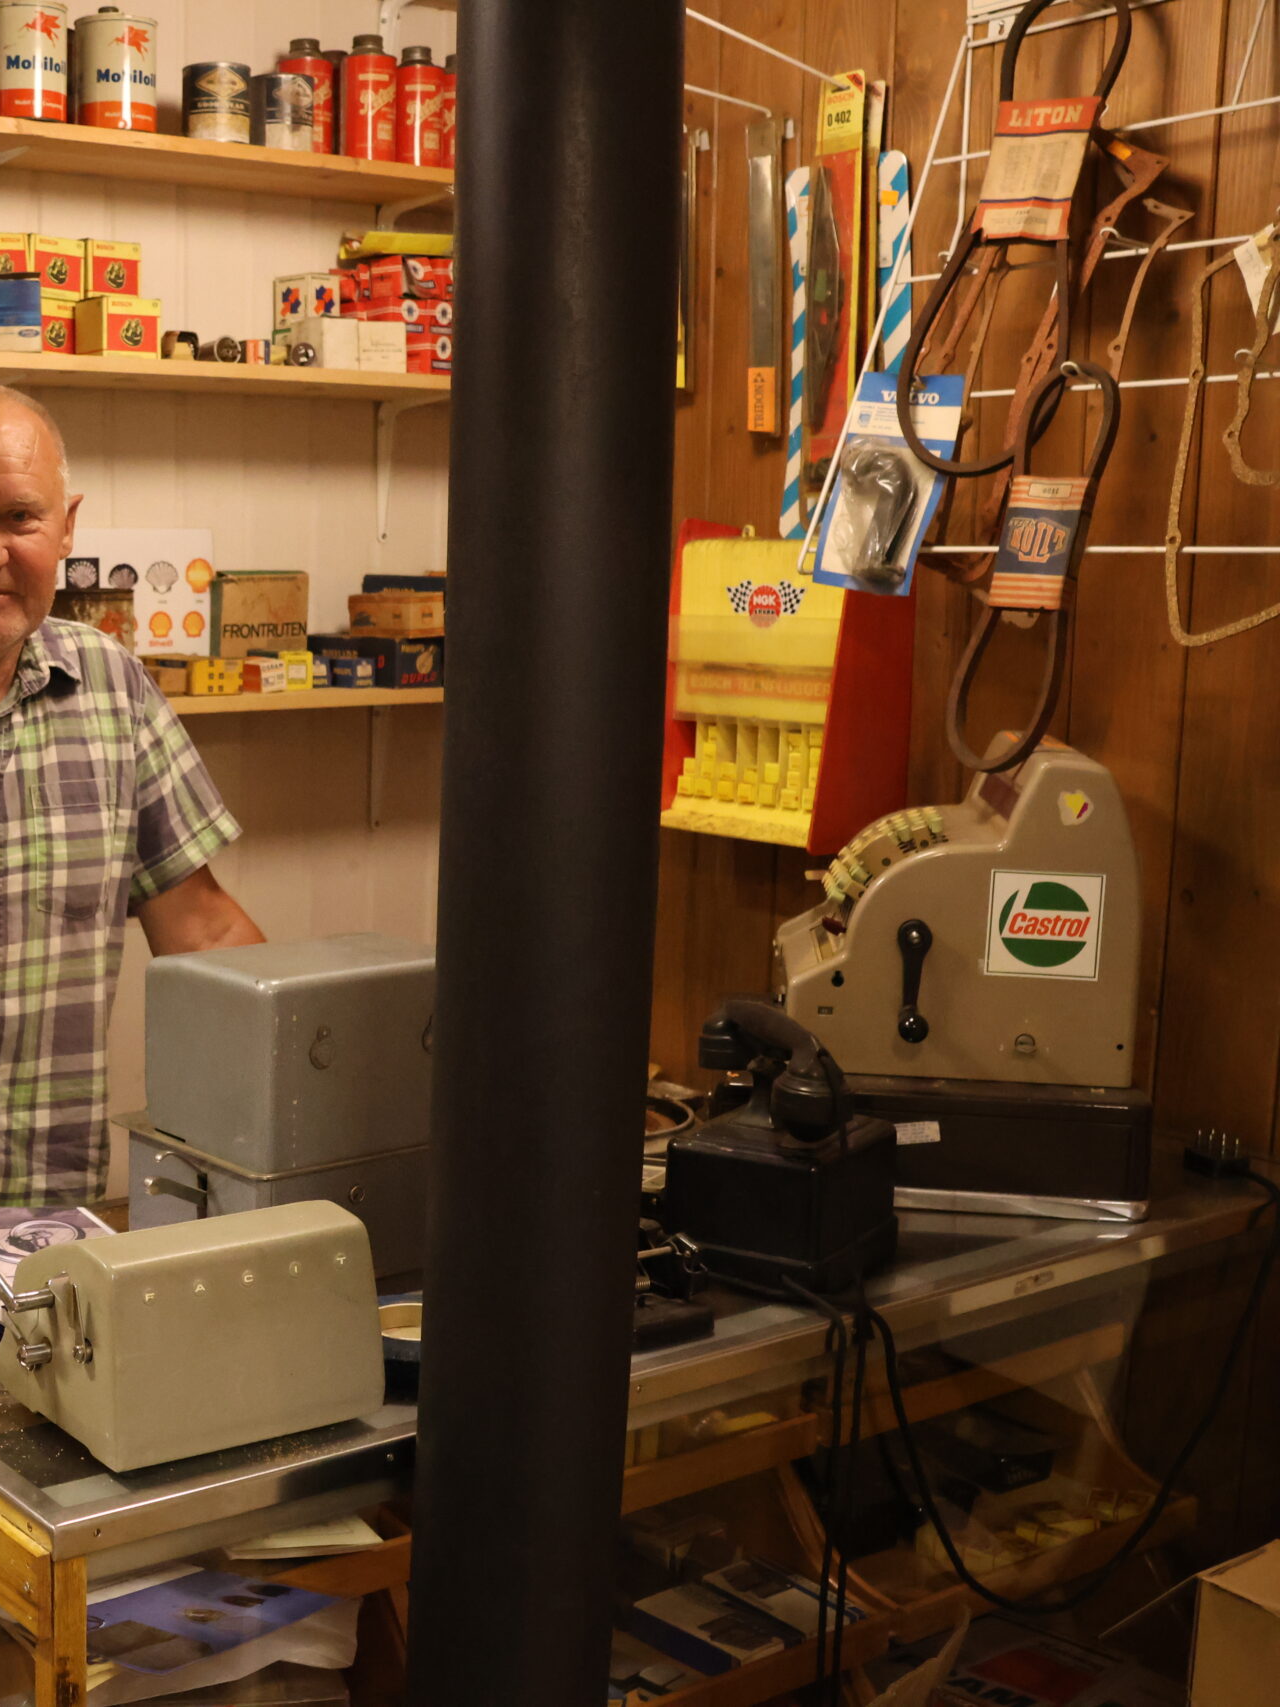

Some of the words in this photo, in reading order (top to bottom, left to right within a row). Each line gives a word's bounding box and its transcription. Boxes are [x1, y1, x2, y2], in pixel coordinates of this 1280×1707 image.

[6, 54, 67, 75] Moiloil
[96, 68, 156, 89] Moiloil
[834, 109, 852, 125] 402
[1008, 104, 1084, 127] LITON
[880, 389, 940, 406] VLVO
[222, 621, 308, 640] FRONTRUTEN
[1007, 912, 1092, 938] Castrol
